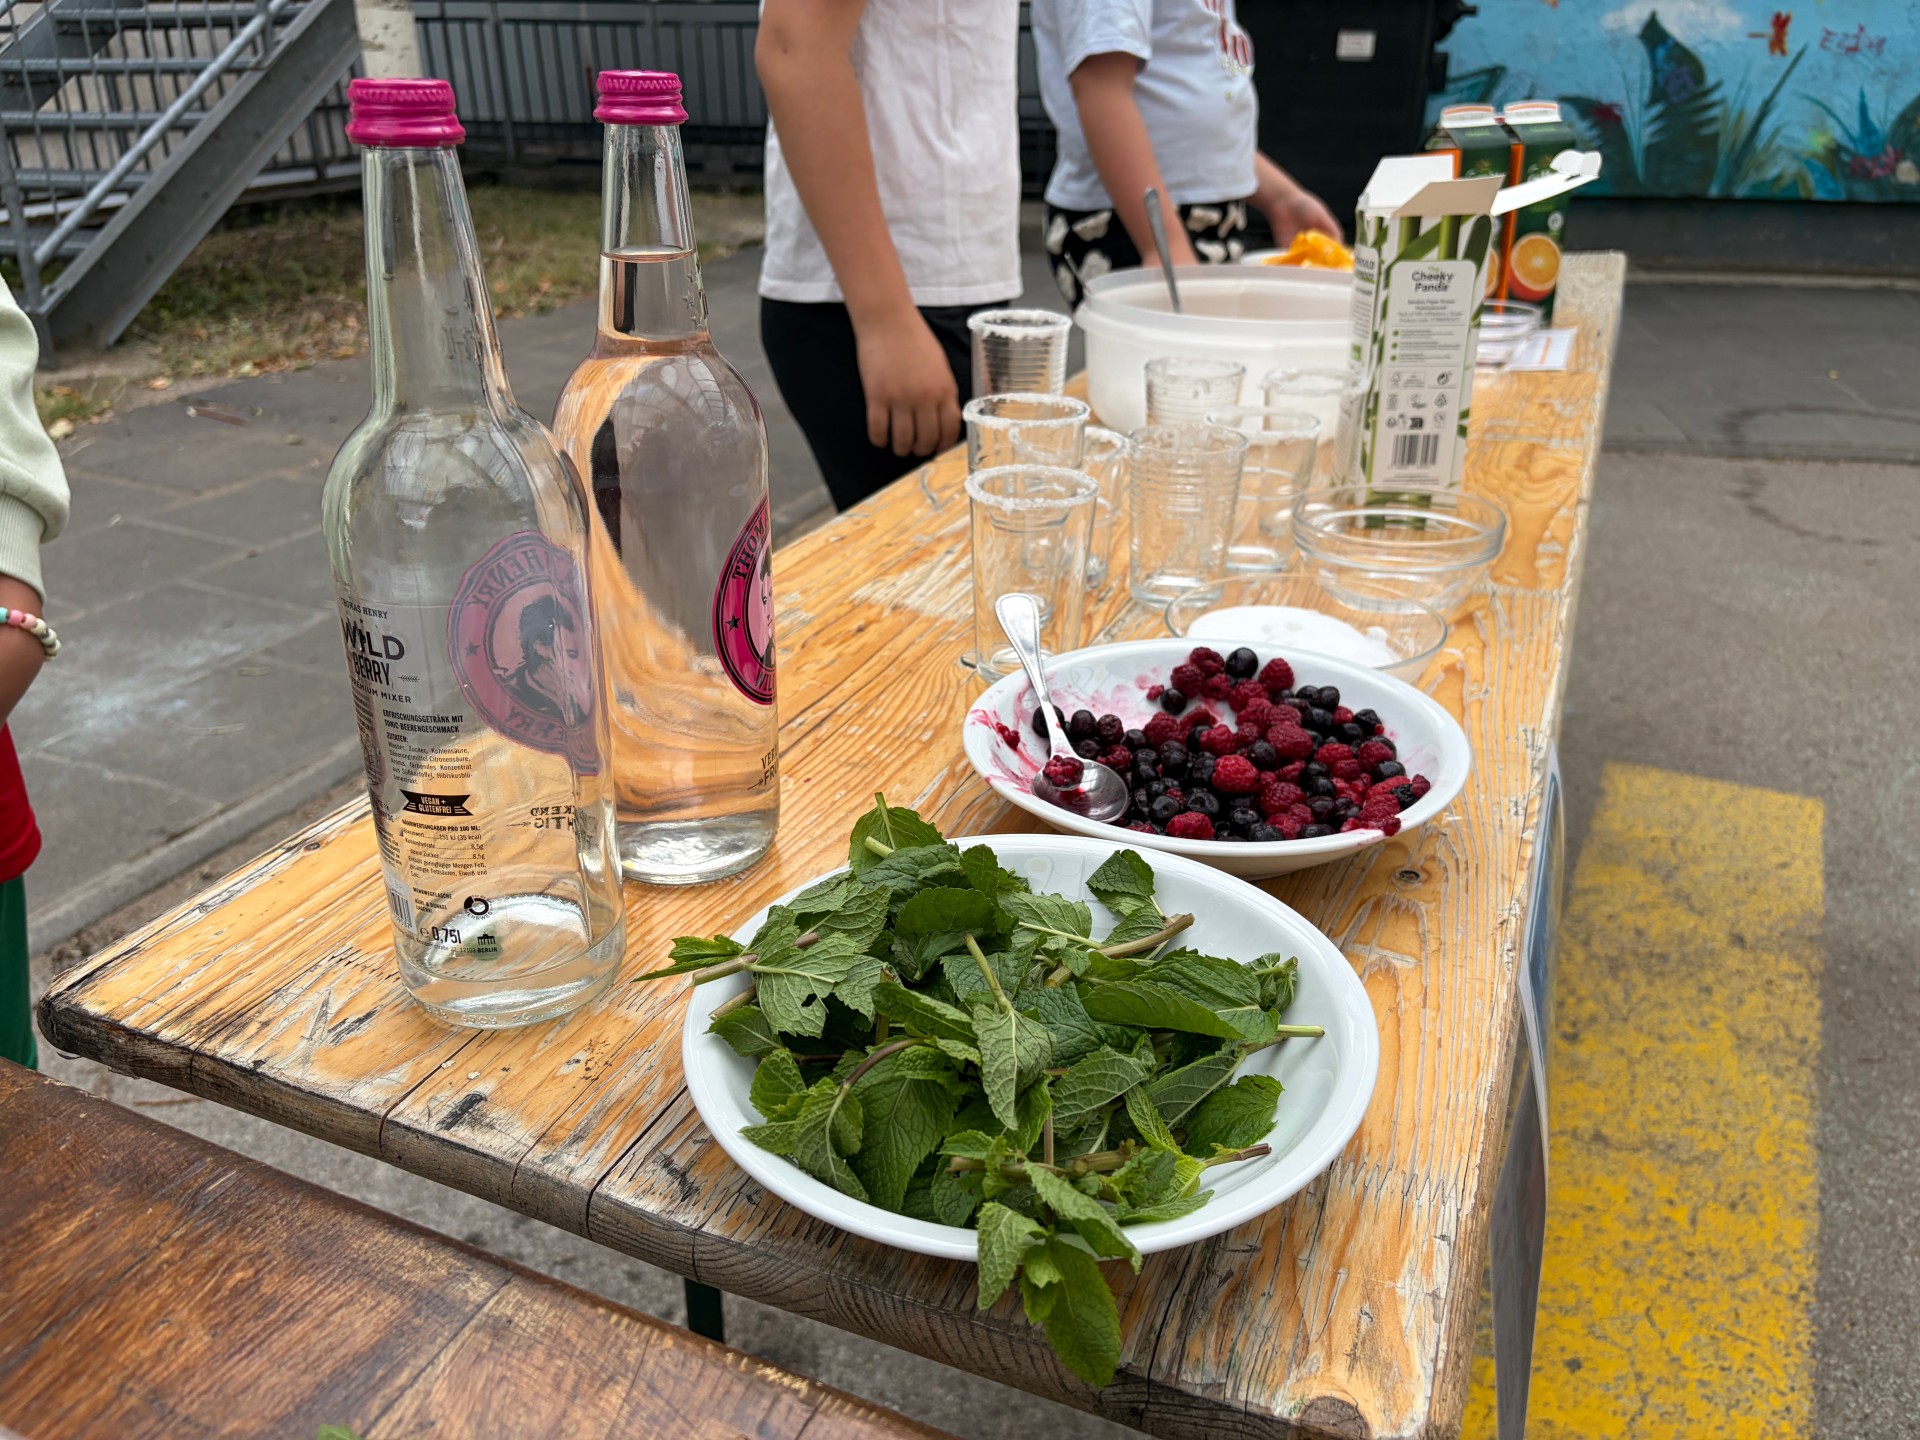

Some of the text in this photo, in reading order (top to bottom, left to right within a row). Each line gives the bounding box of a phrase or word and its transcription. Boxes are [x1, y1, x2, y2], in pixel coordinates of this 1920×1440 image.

[1411, 270, 1455, 283] Cheeky
[1414, 282, 1449, 293] Panda
[363, 606, 389, 619] HENRY
[341, 616, 405, 661] WILD
[352, 652, 390, 686] BERRY
[381, 691, 412, 704] MIXER
[382, 708, 464, 724] ERFRISCHUNGSGETRÄNK MIT
[384, 719, 460, 734] TONIC-BEERENGESCHMACK
[386, 731, 409, 743] ZUTATEN:
[420, 796, 440, 806] VEGAN
[418, 803, 453, 815] GLUTENFREI
[477, 946, 498, 954] BERLIN
